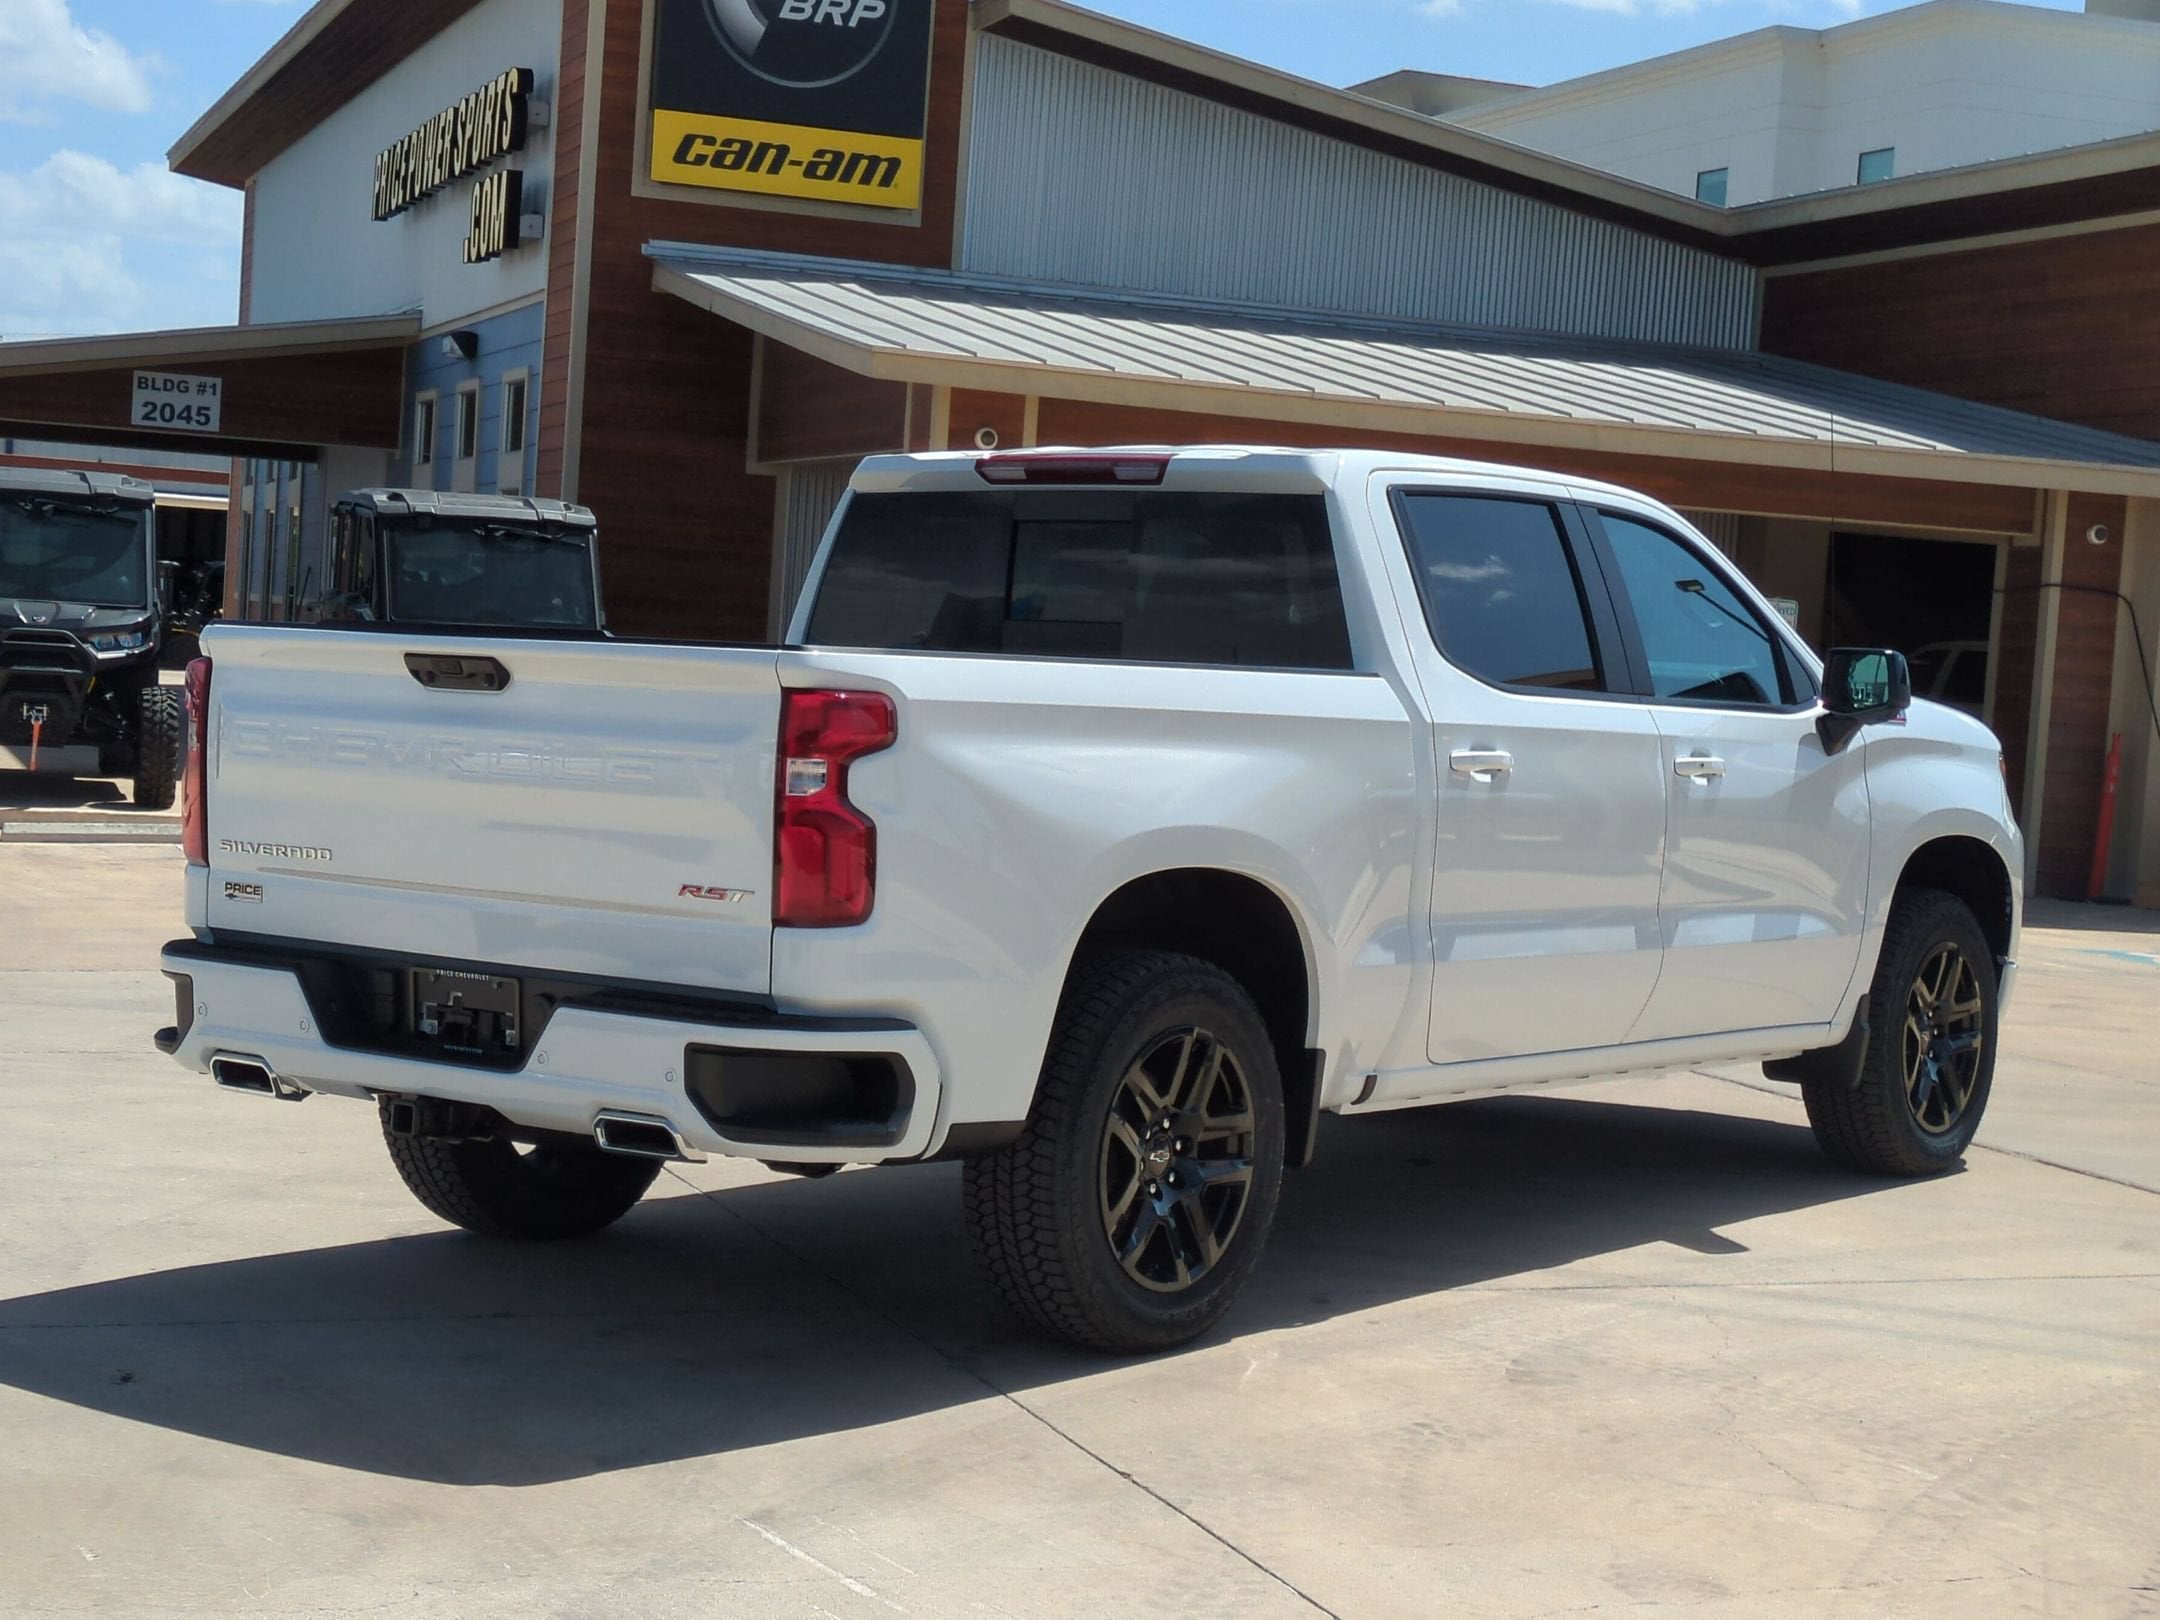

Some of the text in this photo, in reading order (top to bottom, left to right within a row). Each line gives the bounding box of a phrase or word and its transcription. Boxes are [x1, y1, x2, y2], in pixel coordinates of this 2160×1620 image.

[778, 0, 886, 28] BRP
[371, 135, 410, 221] PRICE
[453, 66, 521, 178] SPORTS
[672, 133, 902, 189] can-am
[463, 169, 510, 264] .COM
[137, 376, 217, 397] BLDG #1
[141, 401, 211, 426] 2045
[231, 717, 722, 799] CHEVROLET
[219, 839, 333, 861] SILVERADO
[224, 881, 261, 897] PRICE
[678, 884, 755, 904] RST
[436, 968, 490, 982] PRICE CHEVROLET
